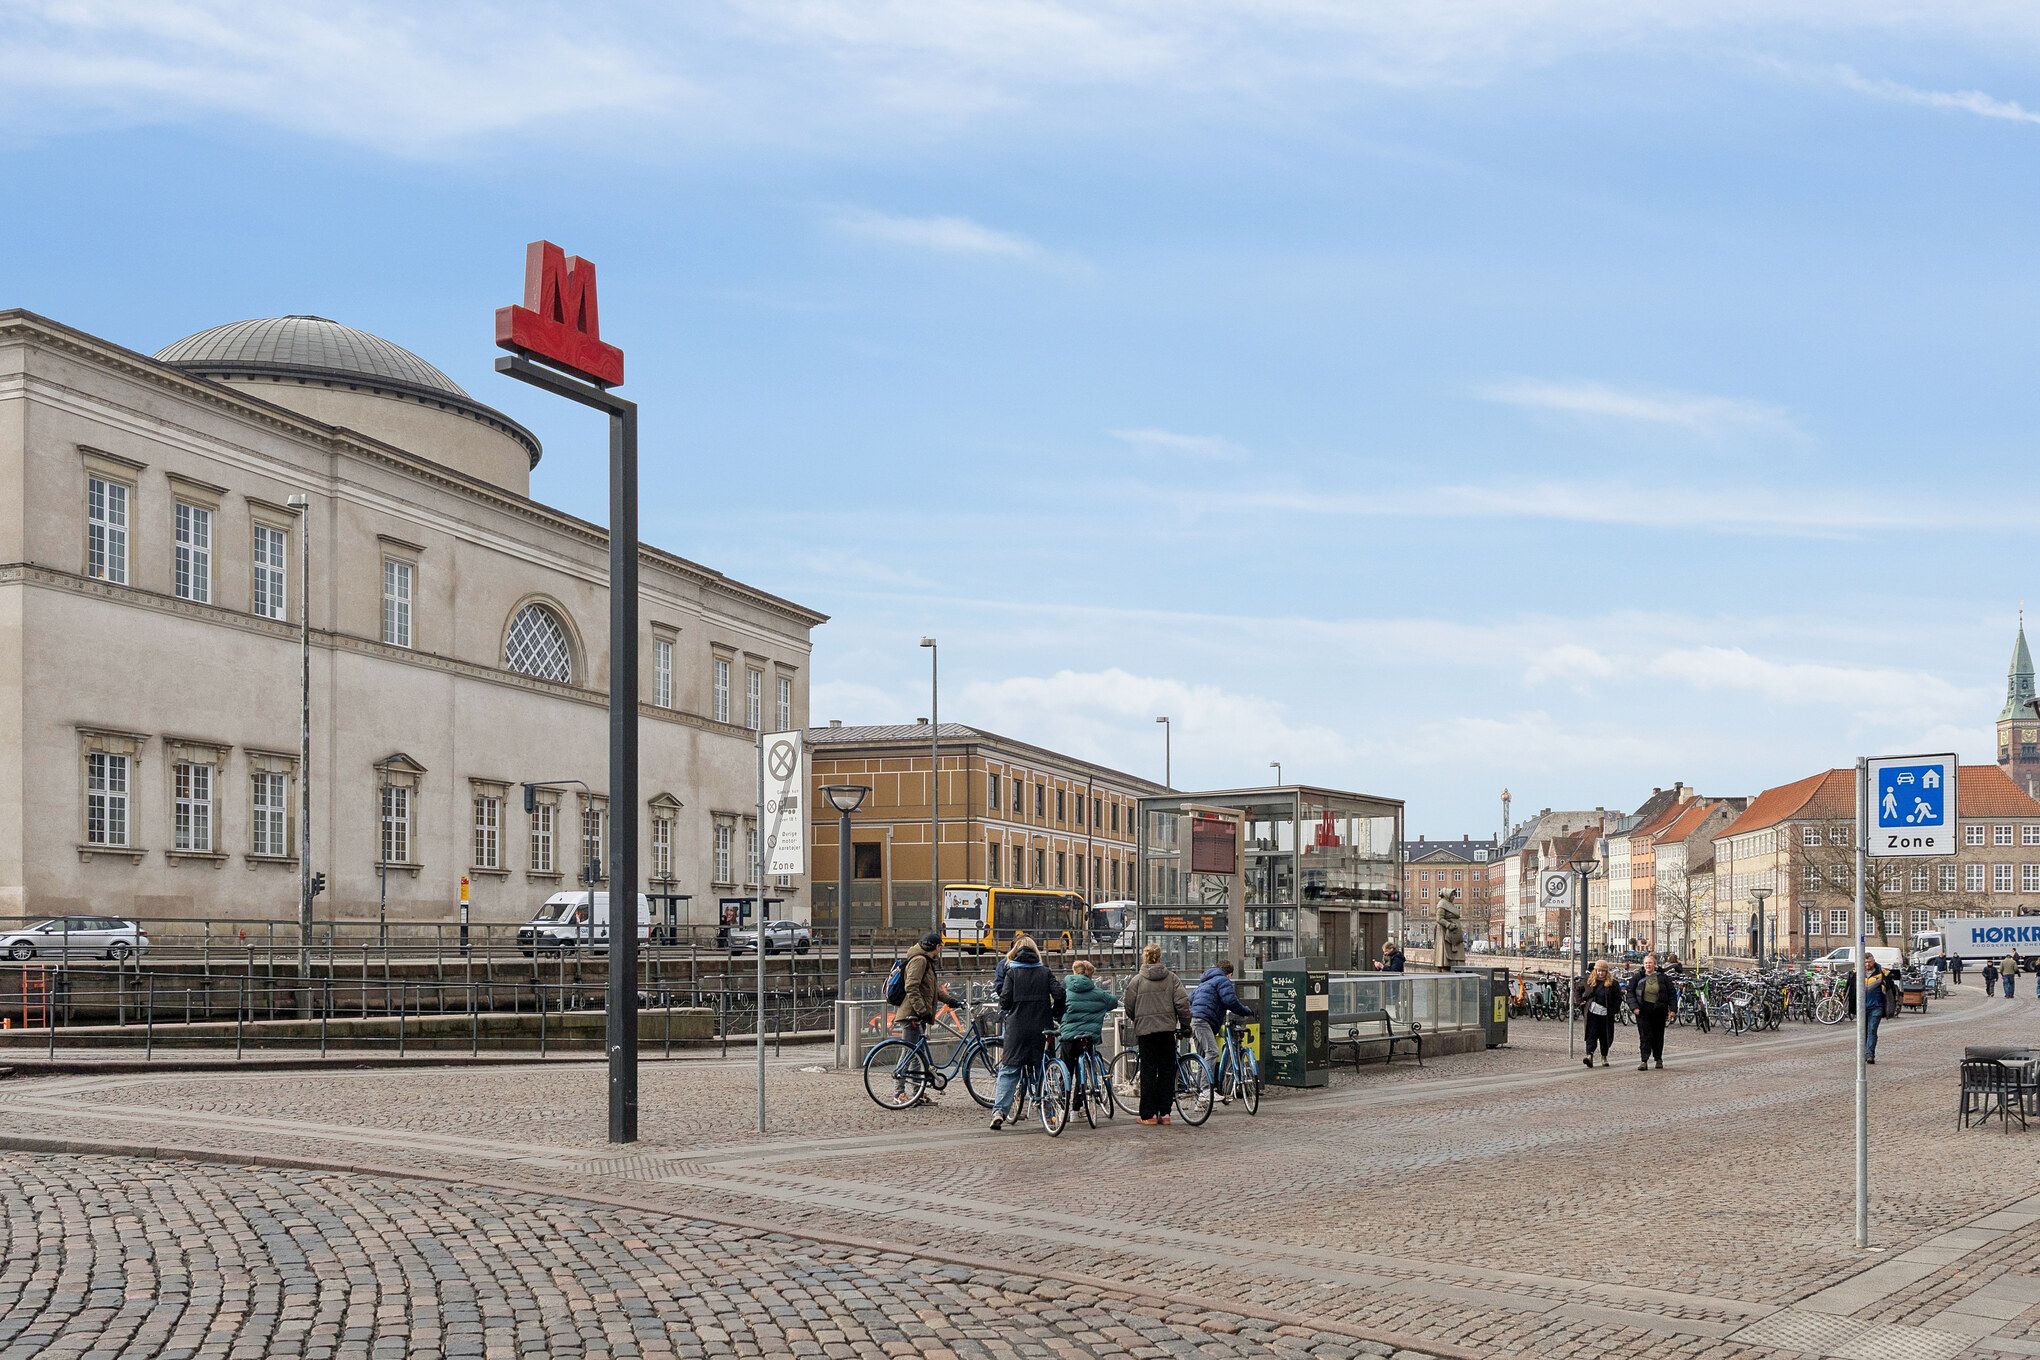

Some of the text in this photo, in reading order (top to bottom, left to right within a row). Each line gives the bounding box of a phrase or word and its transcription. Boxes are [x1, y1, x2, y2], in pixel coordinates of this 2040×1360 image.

[1888, 835, 1935, 848] Zone
[773, 861, 794, 870] Zone
[1550, 882, 1563, 890] 30
[1972, 926, 2040, 943] HØRKR
